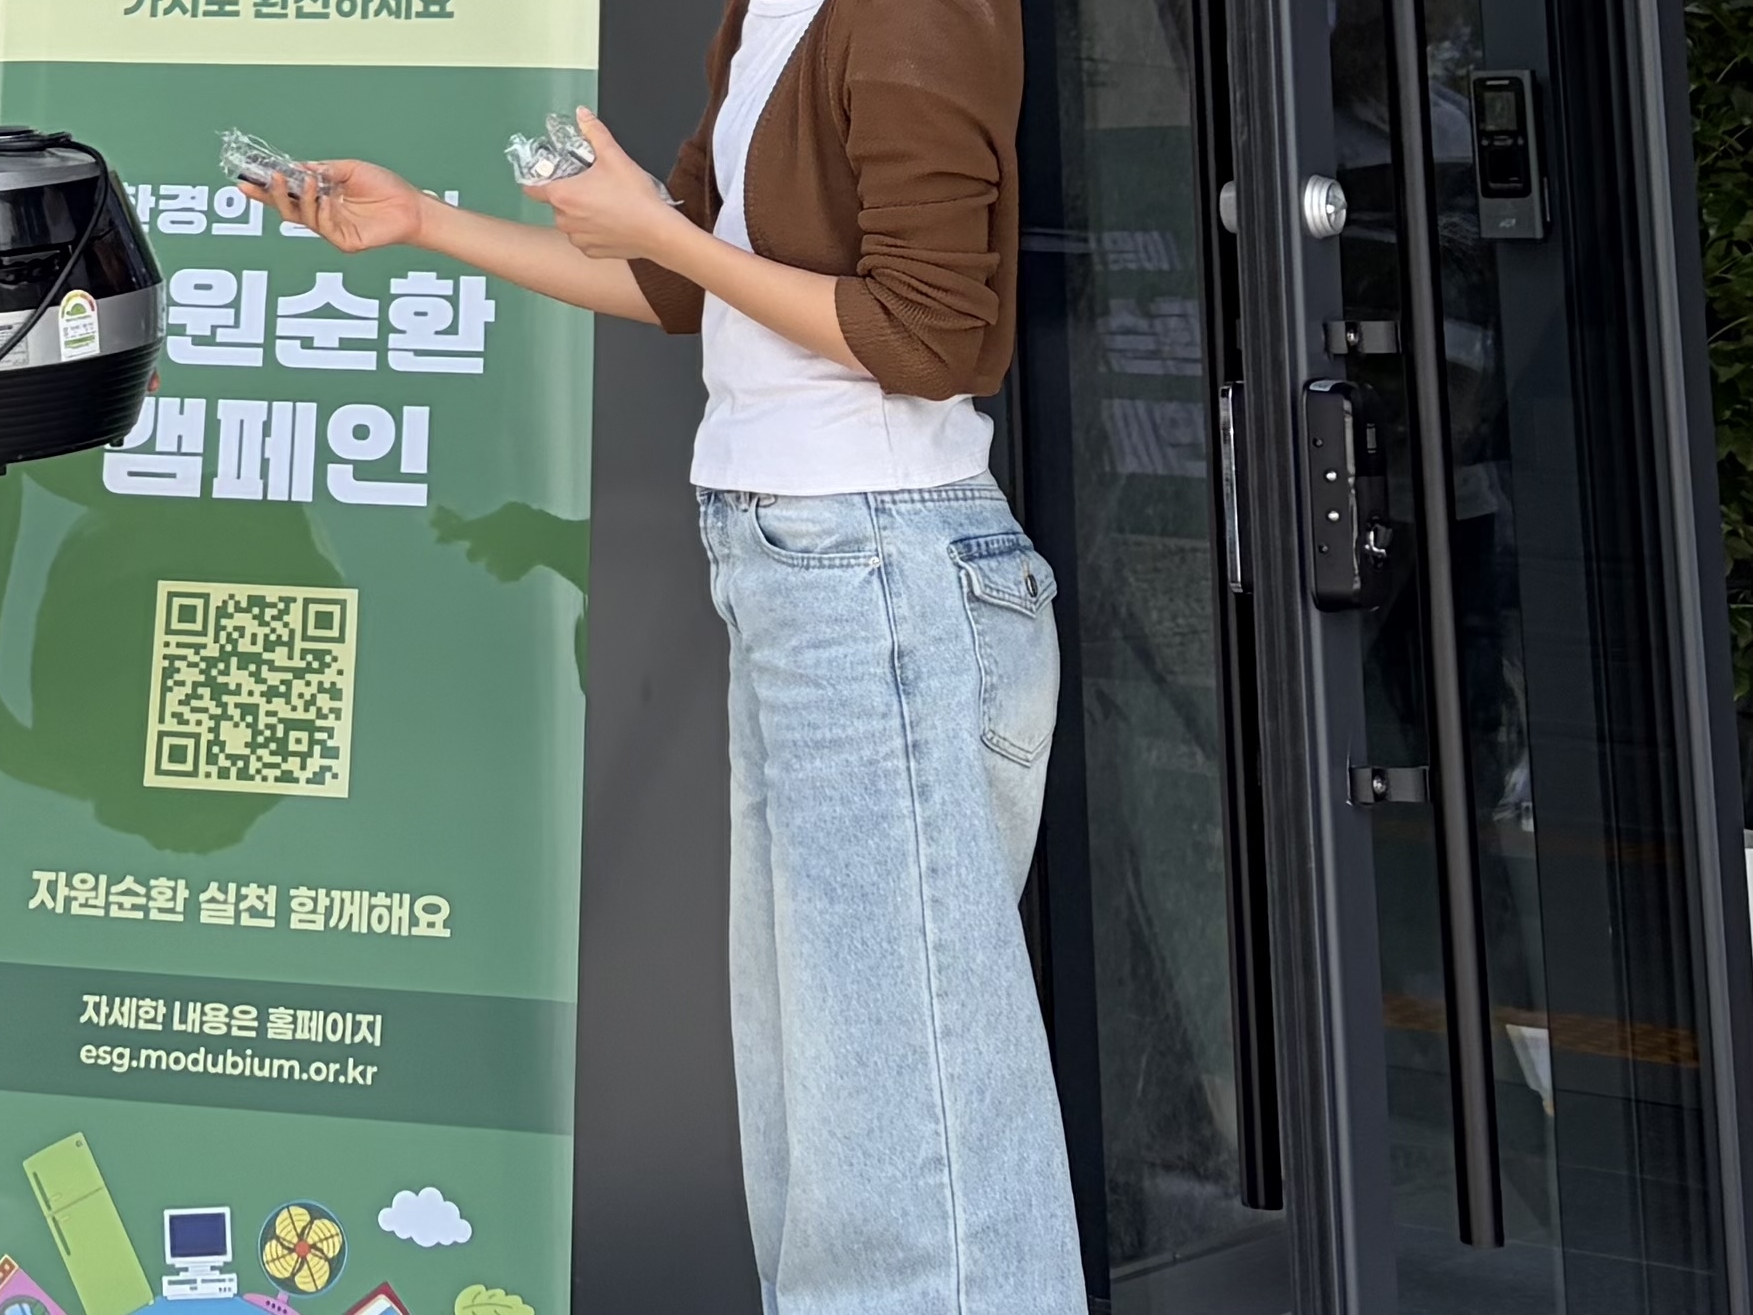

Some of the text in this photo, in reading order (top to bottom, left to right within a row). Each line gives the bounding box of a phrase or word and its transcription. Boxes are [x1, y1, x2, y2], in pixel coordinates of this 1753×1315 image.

[102, 396, 431, 507] 캠페인
[28, 870, 452, 938] 자원순환 실천 함께해요
[79, 994, 383, 1047] 자세한 내용은 홈페이지
[79, 1042, 379, 1087] esg.modubium.or.kr
